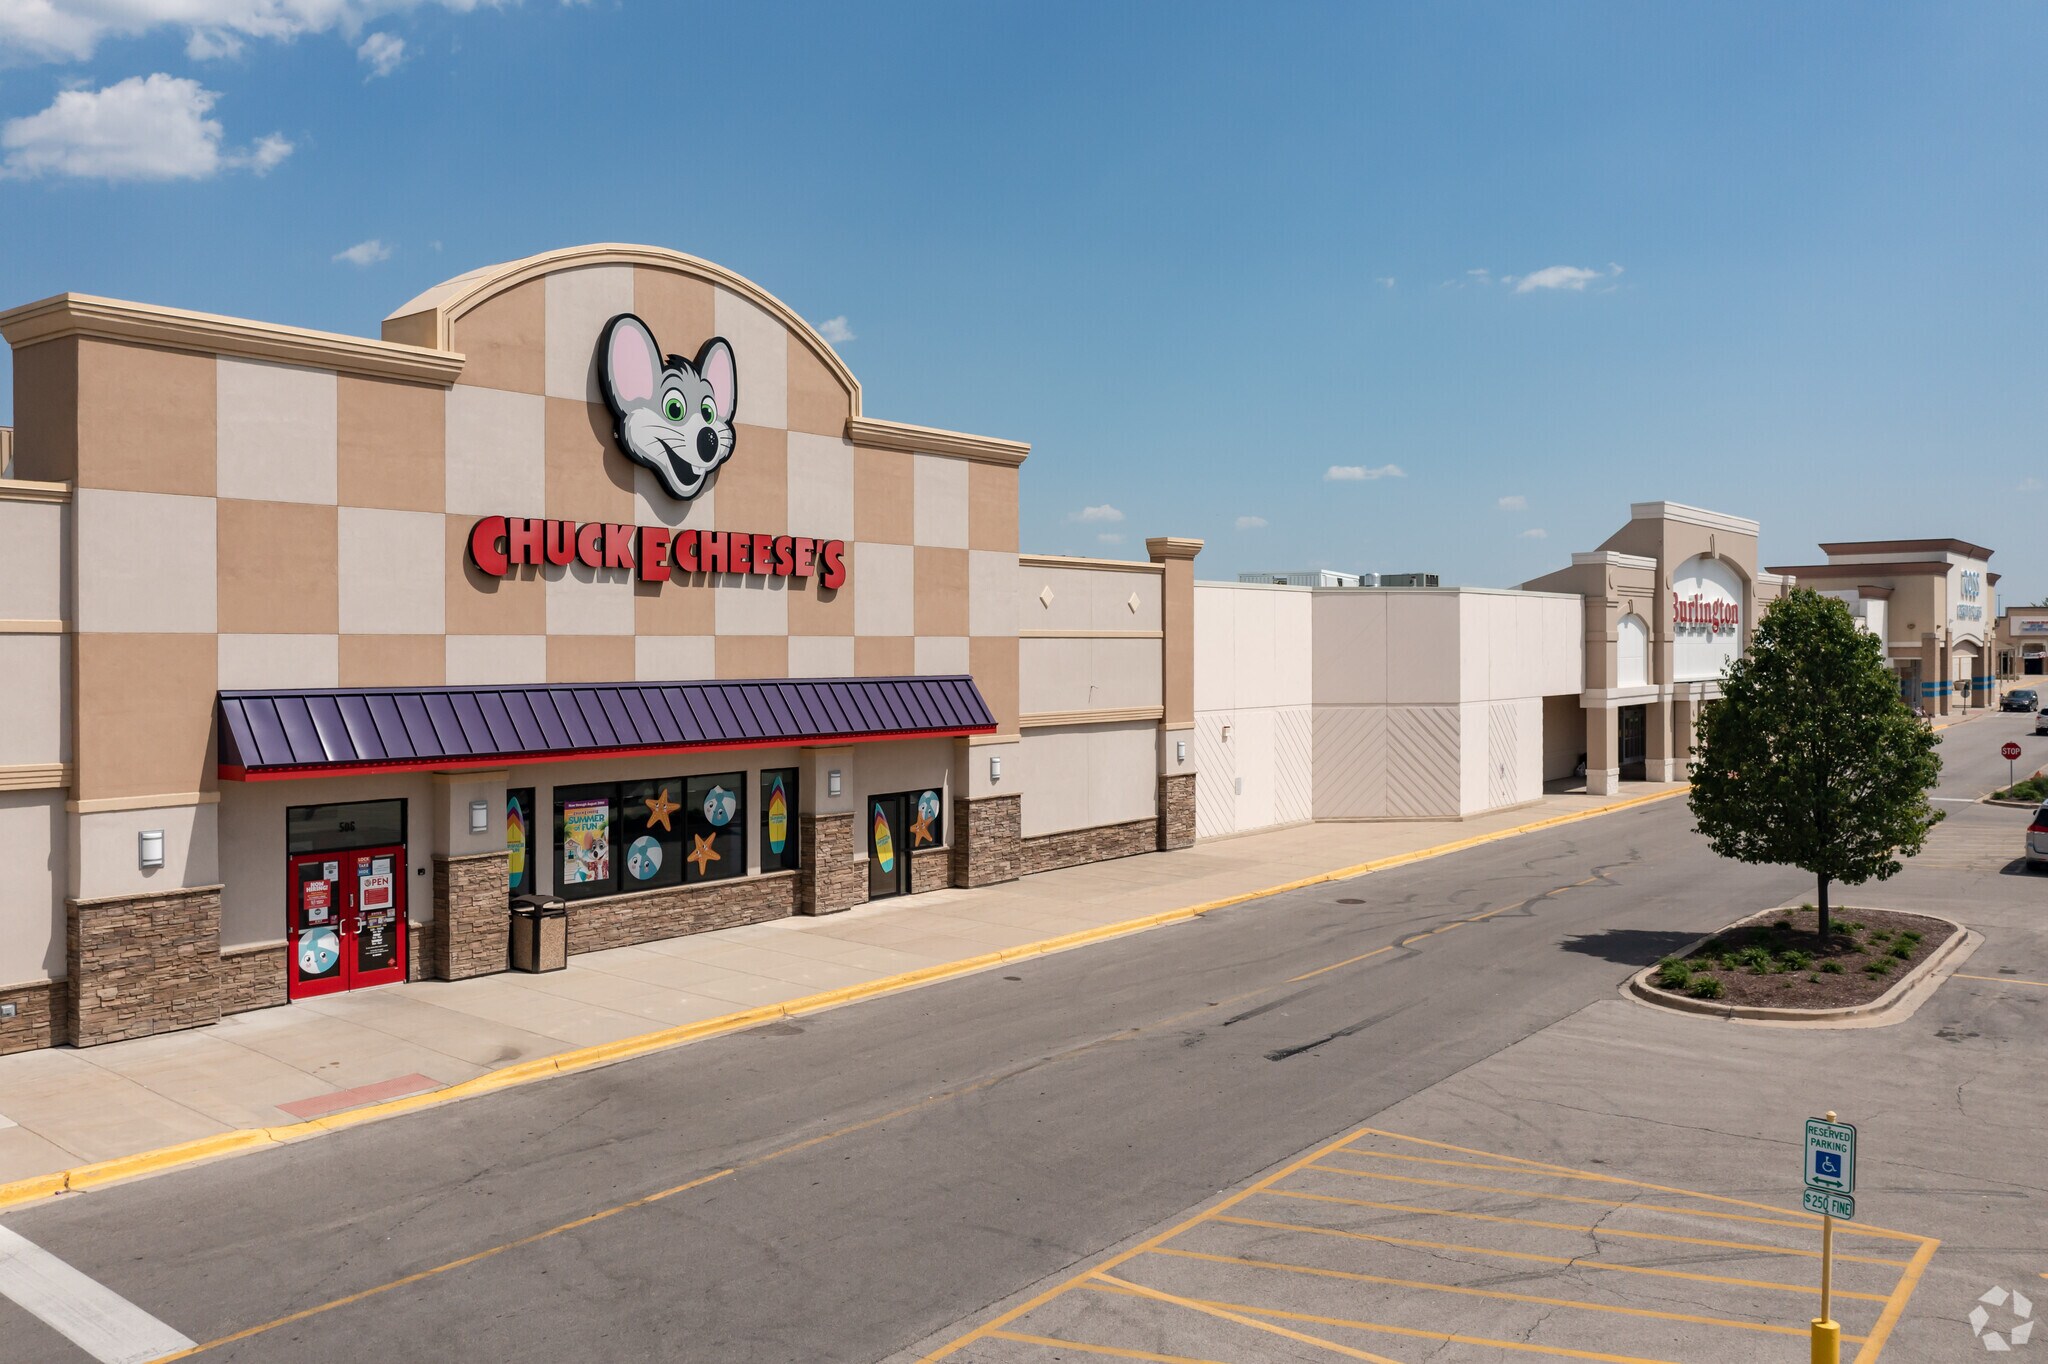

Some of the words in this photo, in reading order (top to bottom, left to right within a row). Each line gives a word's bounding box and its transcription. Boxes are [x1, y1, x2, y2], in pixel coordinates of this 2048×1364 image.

[468, 515, 636, 576] CHUCK
[635, 525, 672, 582] E
[672, 528, 847, 590] CHEESE'S
[1673, 592, 1739, 634] Burlington
[2002, 747, 2020, 755] STOP
[339, 821, 356, 832] 506
[568, 814, 604, 824] SUMMER
[582, 823, 598, 831] FUN
[1808, 1126, 1850, 1142] RESERVED
[1810, 1138, 1847, 1153] PARKING
[1832, 1200, 1851, 1216] FINE
